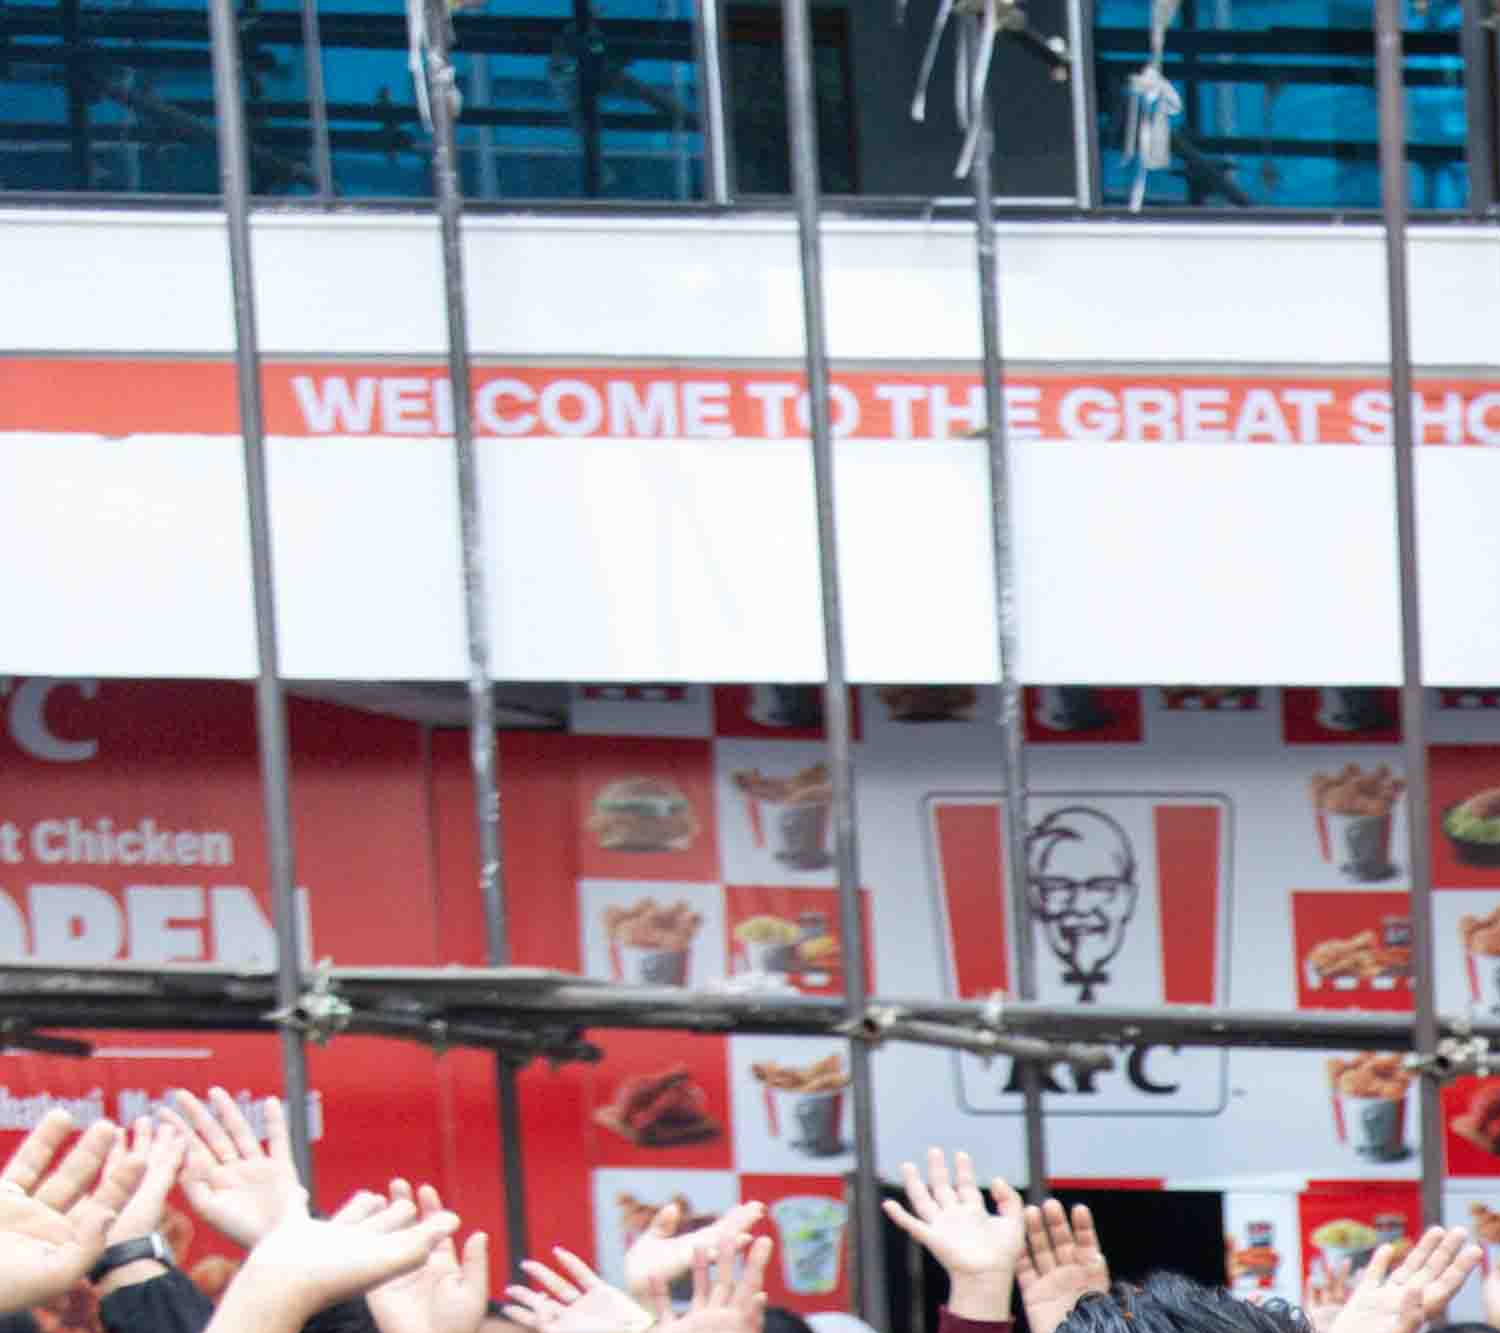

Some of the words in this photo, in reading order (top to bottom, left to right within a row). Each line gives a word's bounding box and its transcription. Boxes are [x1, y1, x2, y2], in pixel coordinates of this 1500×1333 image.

[292, 375, 736, 438] WELCOME
[745, 380, 860, 439] TO
[874, 383, 1041, 441] THE
[1059, 387, 1333, 443] GREAT
[31, 817, 234, 865] Chicken
[0, 884, 310, 966] PEN
